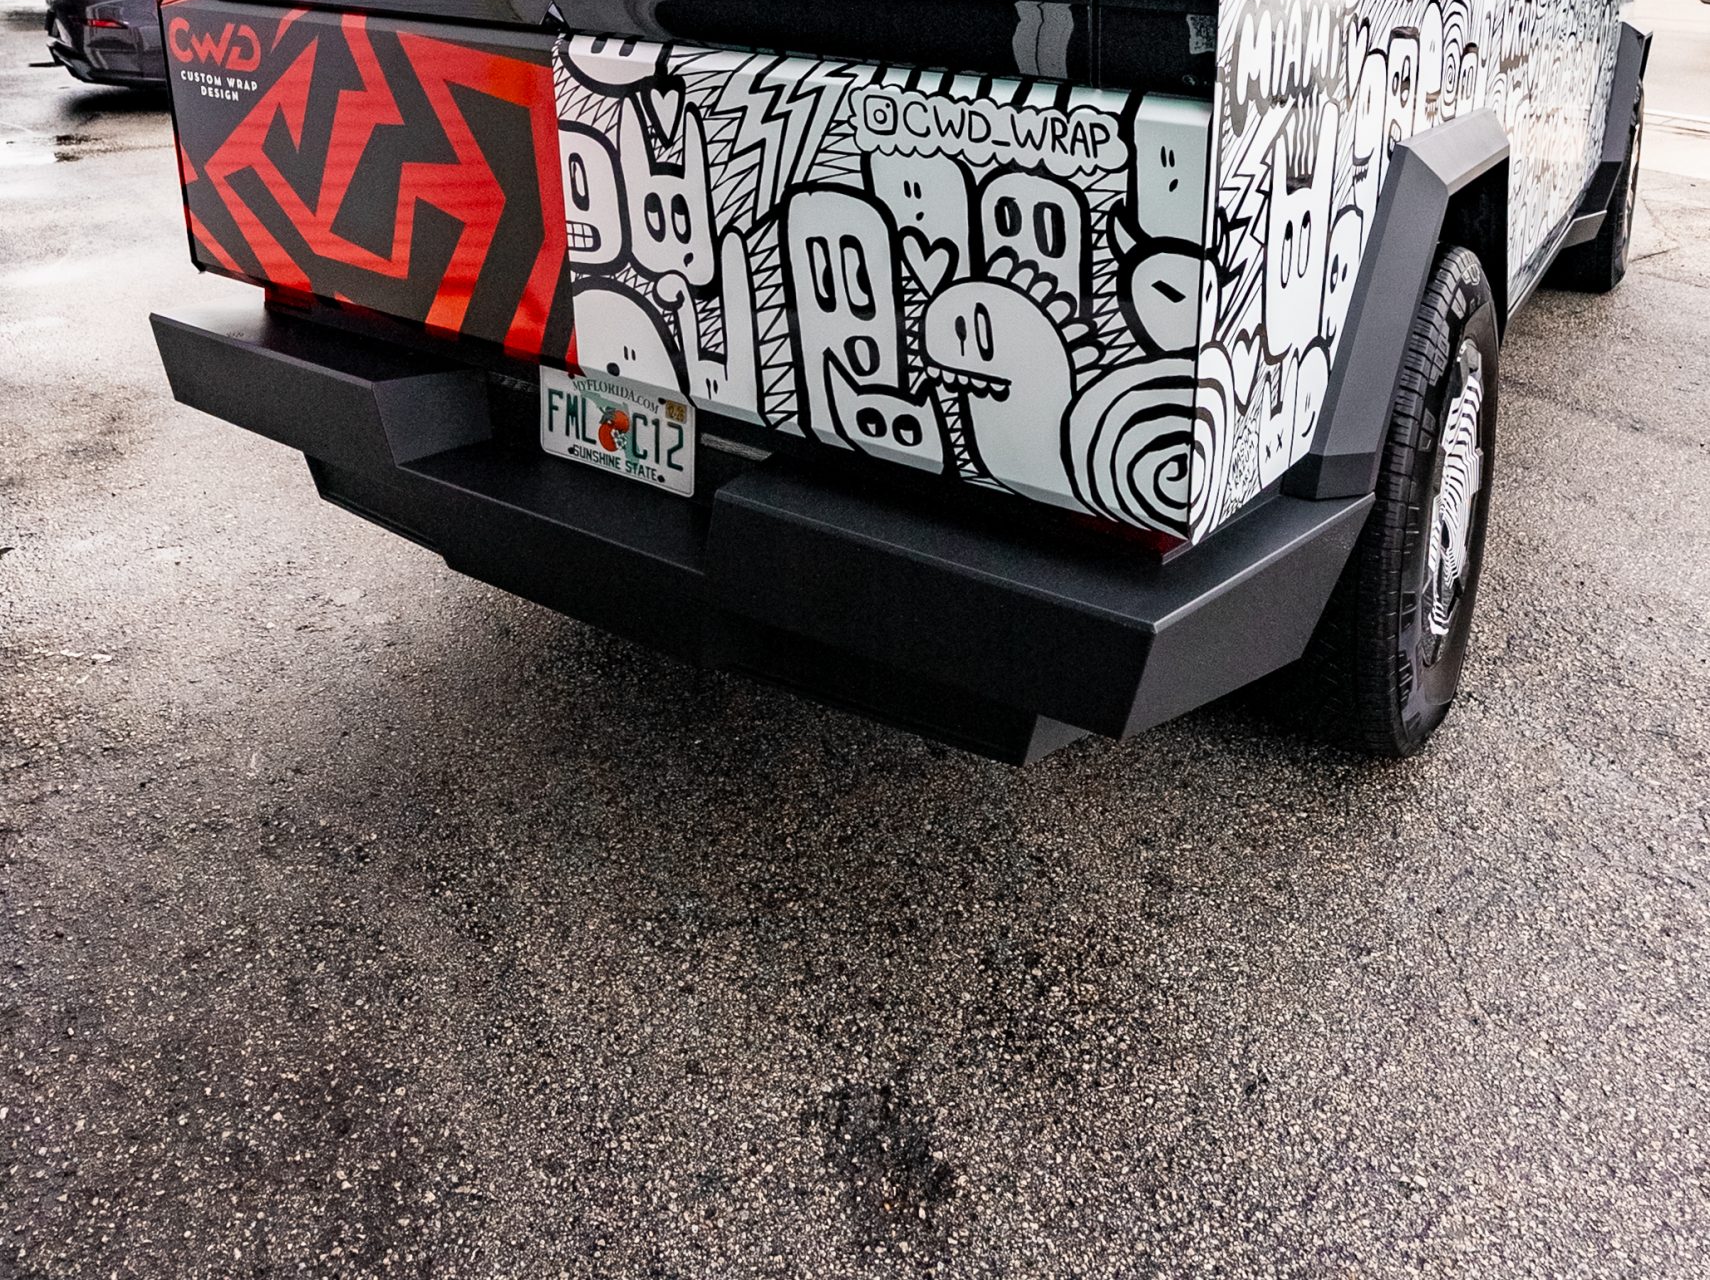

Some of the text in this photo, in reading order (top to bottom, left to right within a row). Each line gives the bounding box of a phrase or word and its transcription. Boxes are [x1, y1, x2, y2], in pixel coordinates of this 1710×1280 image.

[168, 16, 261, 72] CWD
[180, 70, 258, 91] CUSTOM WRAP
[200, 85, 239, 102] DESIGN
[572, 379, 660, 415] MYFLORIDA.COM
[548, 388, 684, 471] FML C12
[572, 444, 658, 482] SUNSHINE STATE
